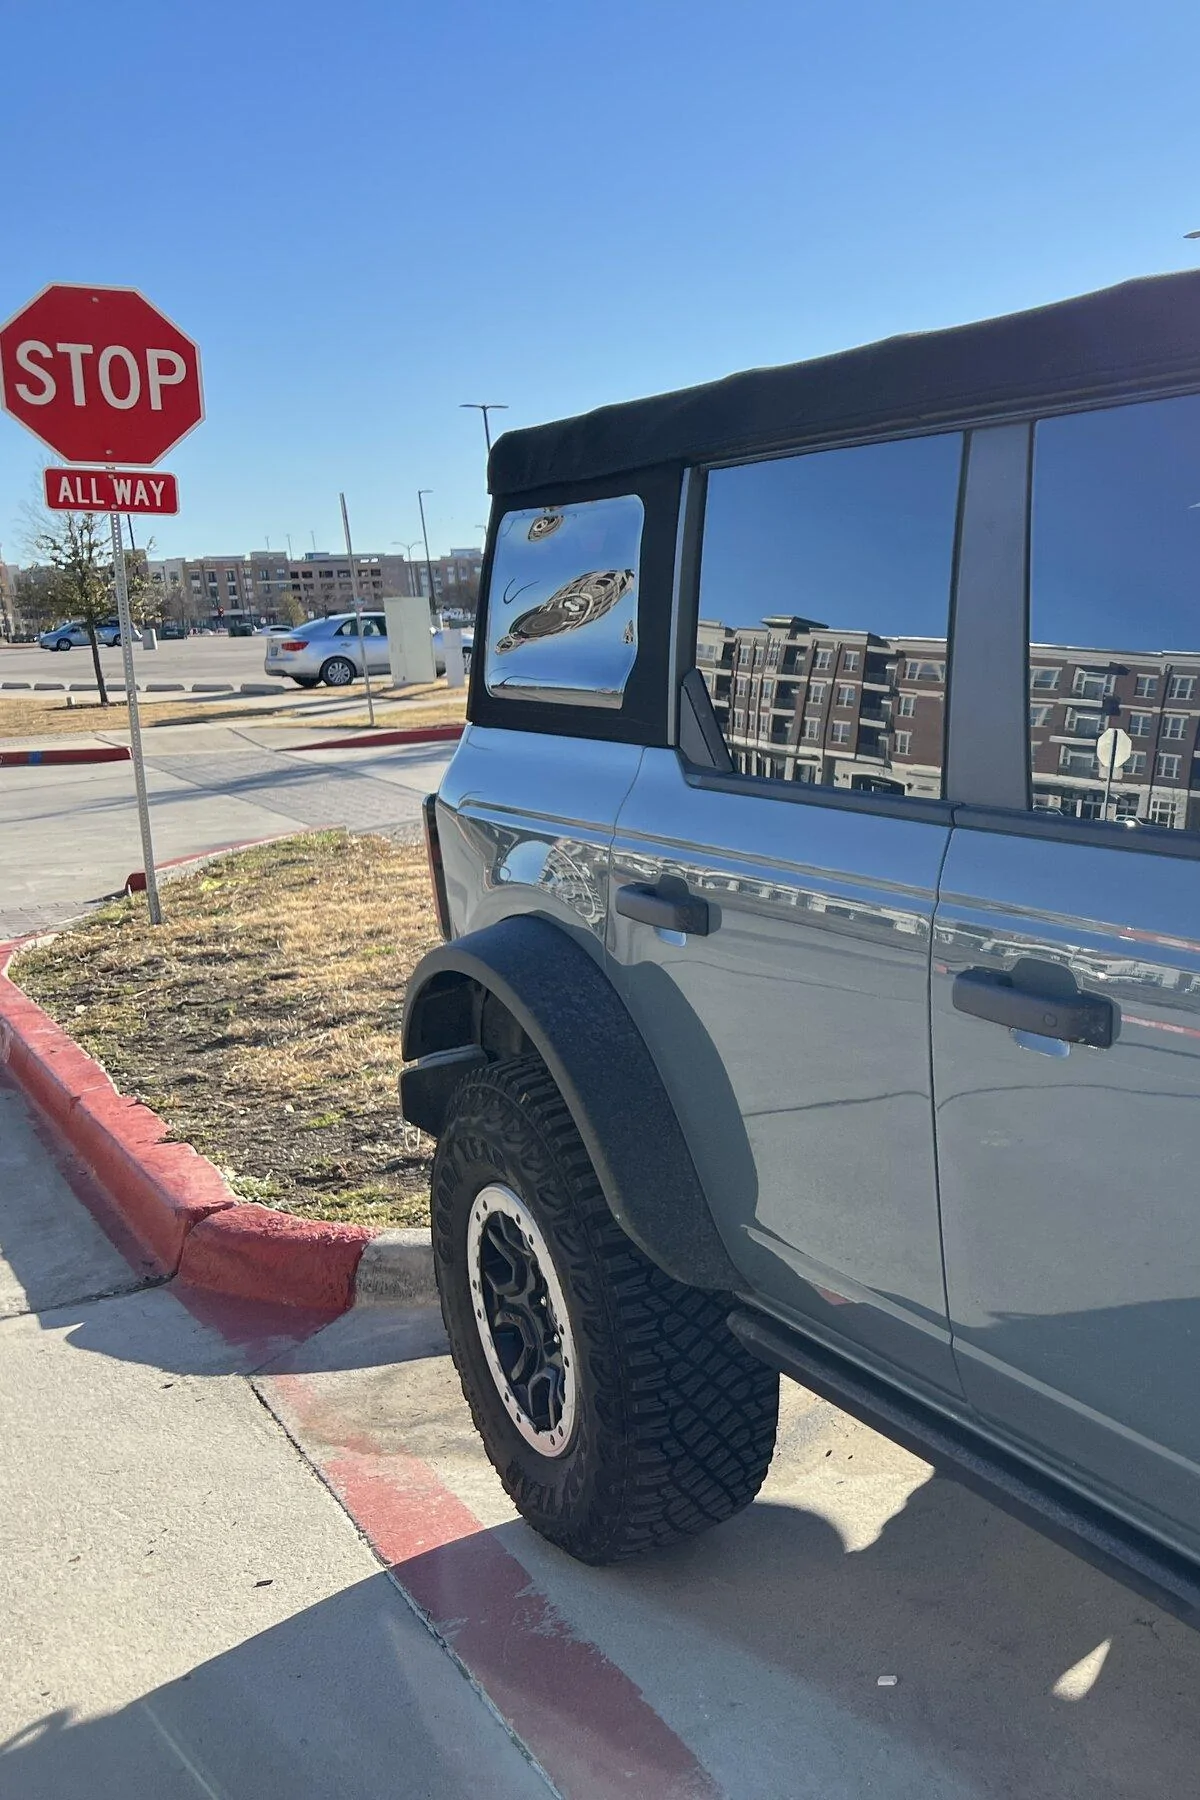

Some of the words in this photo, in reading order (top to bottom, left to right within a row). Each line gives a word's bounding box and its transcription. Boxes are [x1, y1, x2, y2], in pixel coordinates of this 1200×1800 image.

[15, 339, 187, 411] STOP
[58, 476, 105, 505] ALL
[112, 478, 165, 507] WAY
